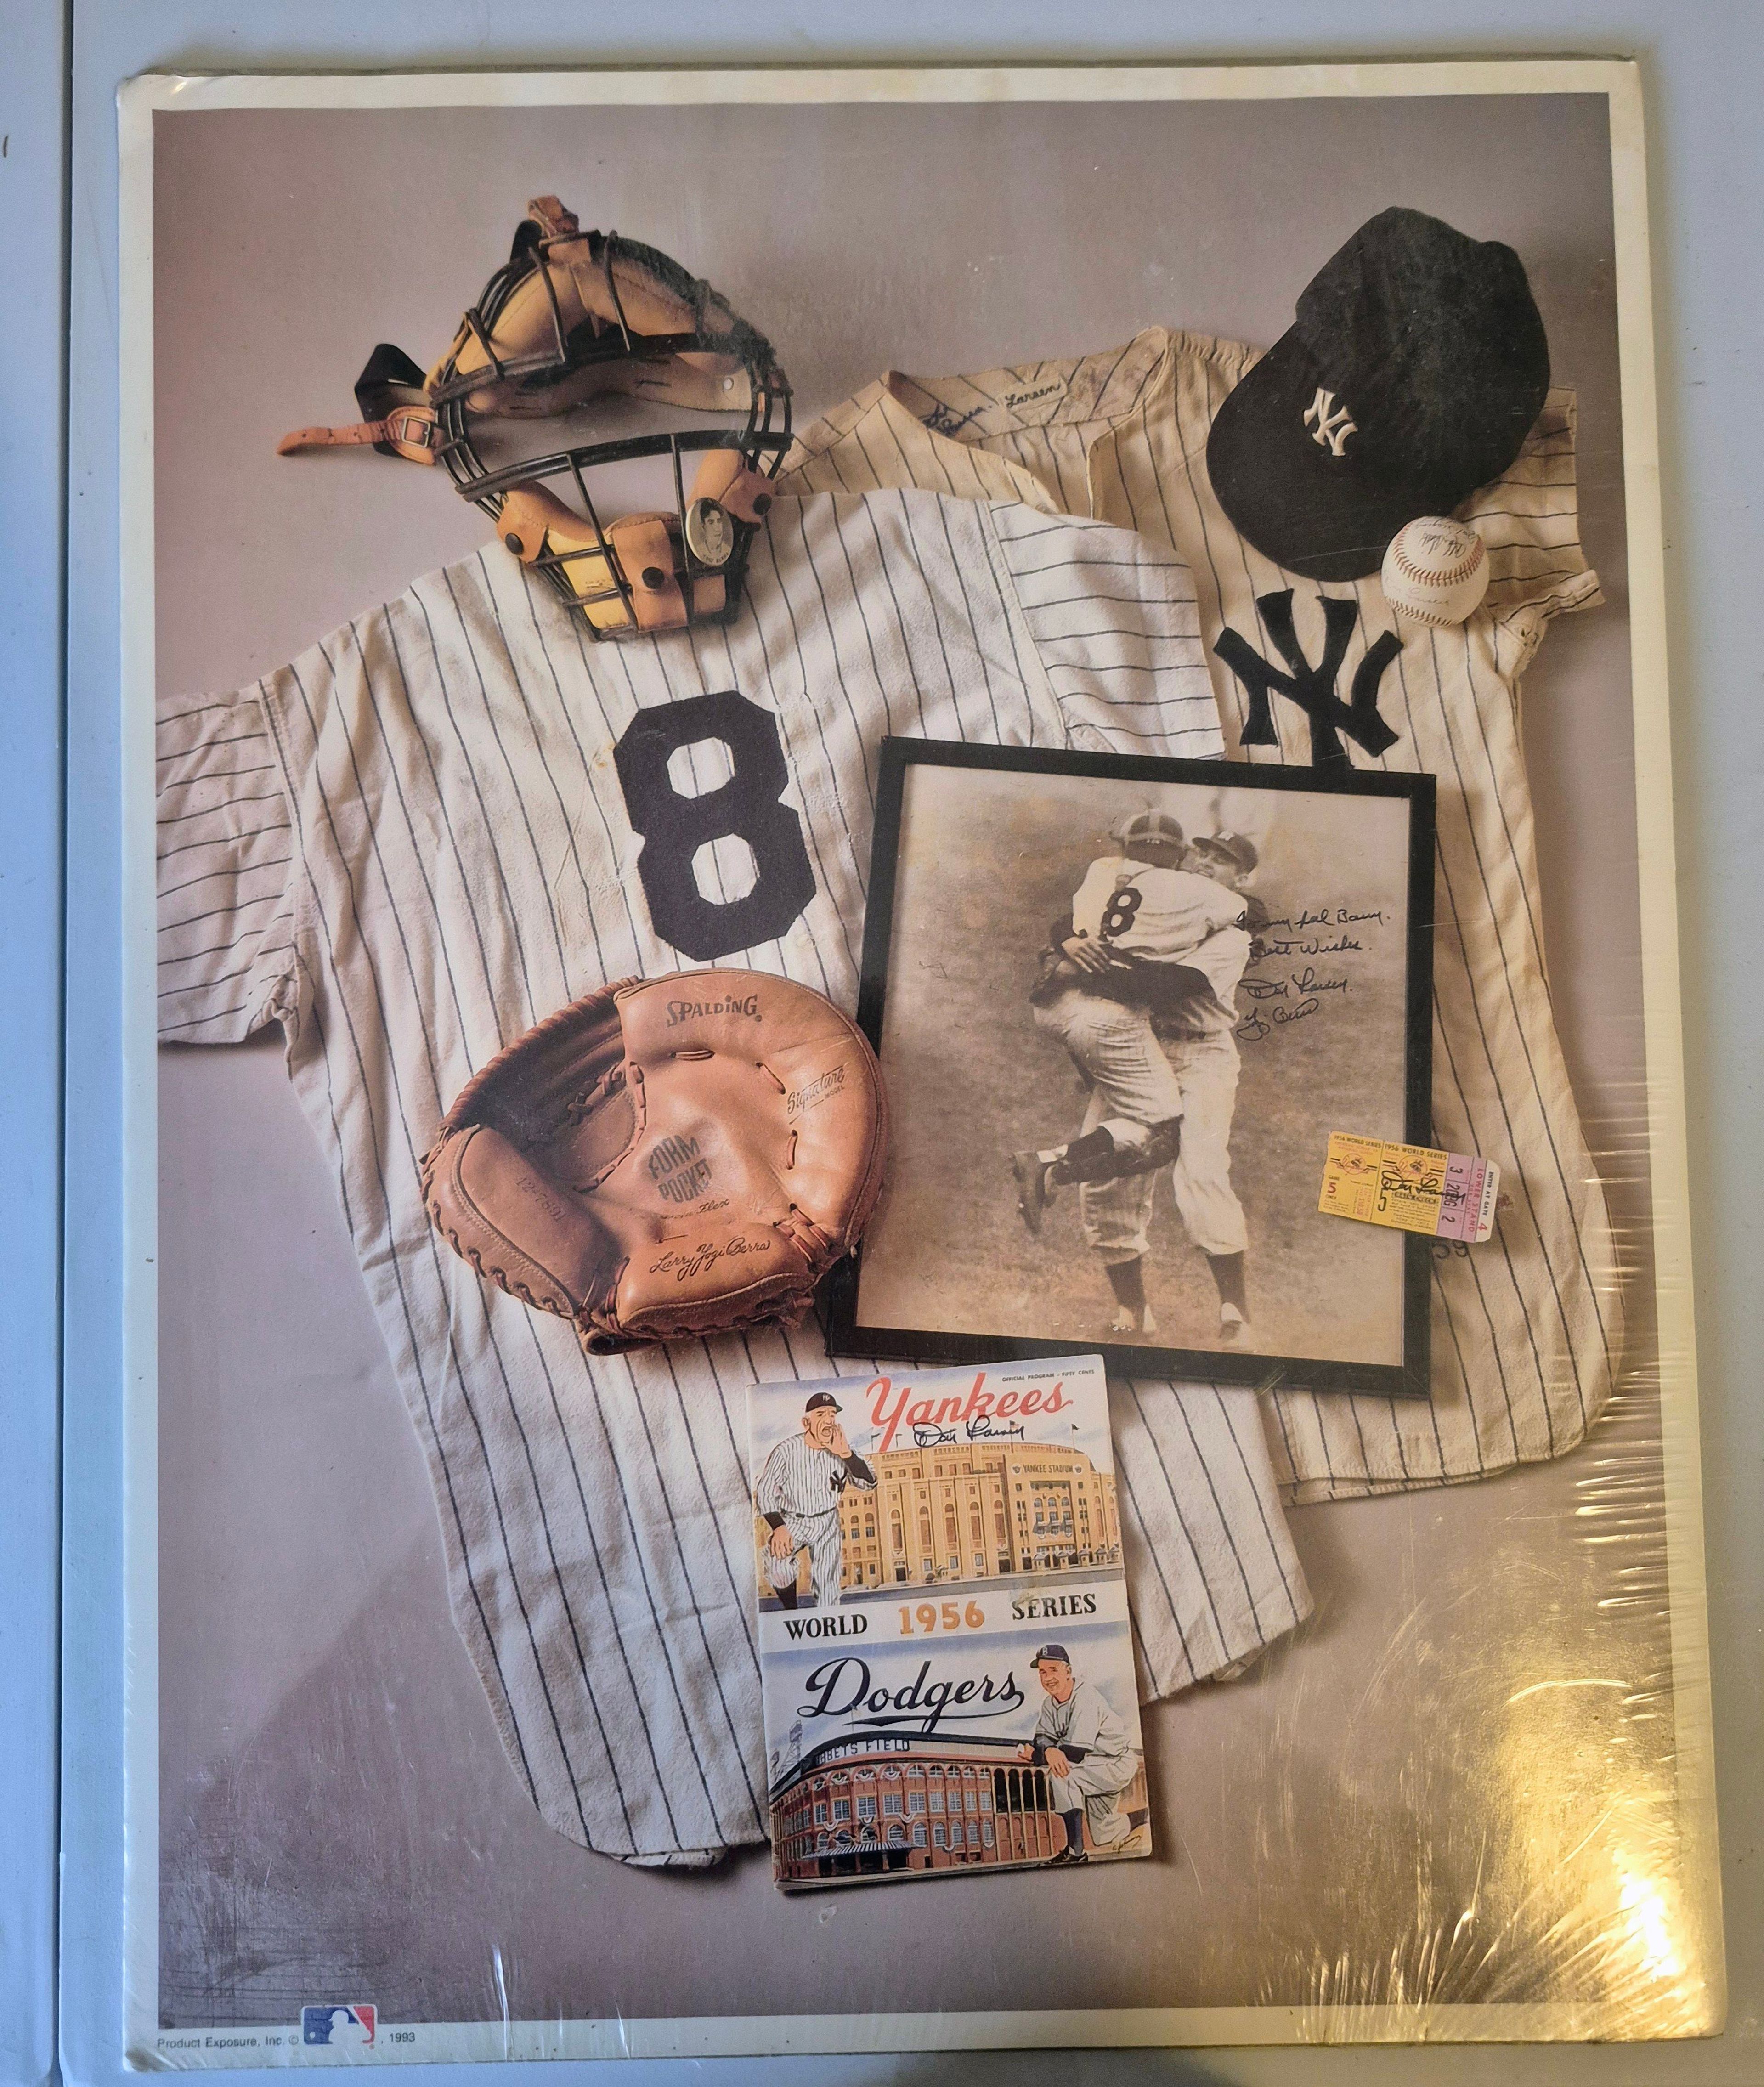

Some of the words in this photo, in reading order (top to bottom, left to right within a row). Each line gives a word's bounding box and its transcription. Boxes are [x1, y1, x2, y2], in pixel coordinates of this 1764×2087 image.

[1006, 384, 1061, 408] Larsen
[613, 690, 816, 962] 8
[1100, 887, 1142, 937] 8
[787, 1067, 845, 1115] Signature
[648, 1135, 701, 1180] FORM
[1402, 1148, 1425, 1156] WORLD
[1426, 1151, 1447, 1160] SERIES
[658, 1158, 712, 1204] POCKET
[1327, 1181, 1337, 1194] 5
[1473, 1168, 1484, 1198] LOWER
[1485, 1190, 1491, 1199] AT
[1377, 1187, 1387, 1212] 5
[1441, 1215, 1456, 1223] 2
[1468, 1202, 1479, 1232] STAND
[1478, 1222, 1488, 1231] 4
[649, 1251, 695, 1281] Larry
[689, 1243, 725, 1277] Yogi
[725, 1236, 771, 1256] Berra
[866, 1372, 1074, 1452] Yankees
[1023, 1464, 1046, 1473] YANKEE
[1048, 1464, 1073, 1473] STADIUM
[783, 1614, 868, 1644] WORLD
[898, 1599, 986, 1635] 1956
[1011, 1592, 1097, 1621] SERIES
[797, 1657, 1025, 1734] Dodgers
[865, 1738, 910, 1752] FIELD
[157, 2037, 201, 2049] Product
[205, 2037, 260, 2049] Exposure,
[265, 2036, 285, 2046] Inc.
[389, 2032, 416, 2043] 1993
